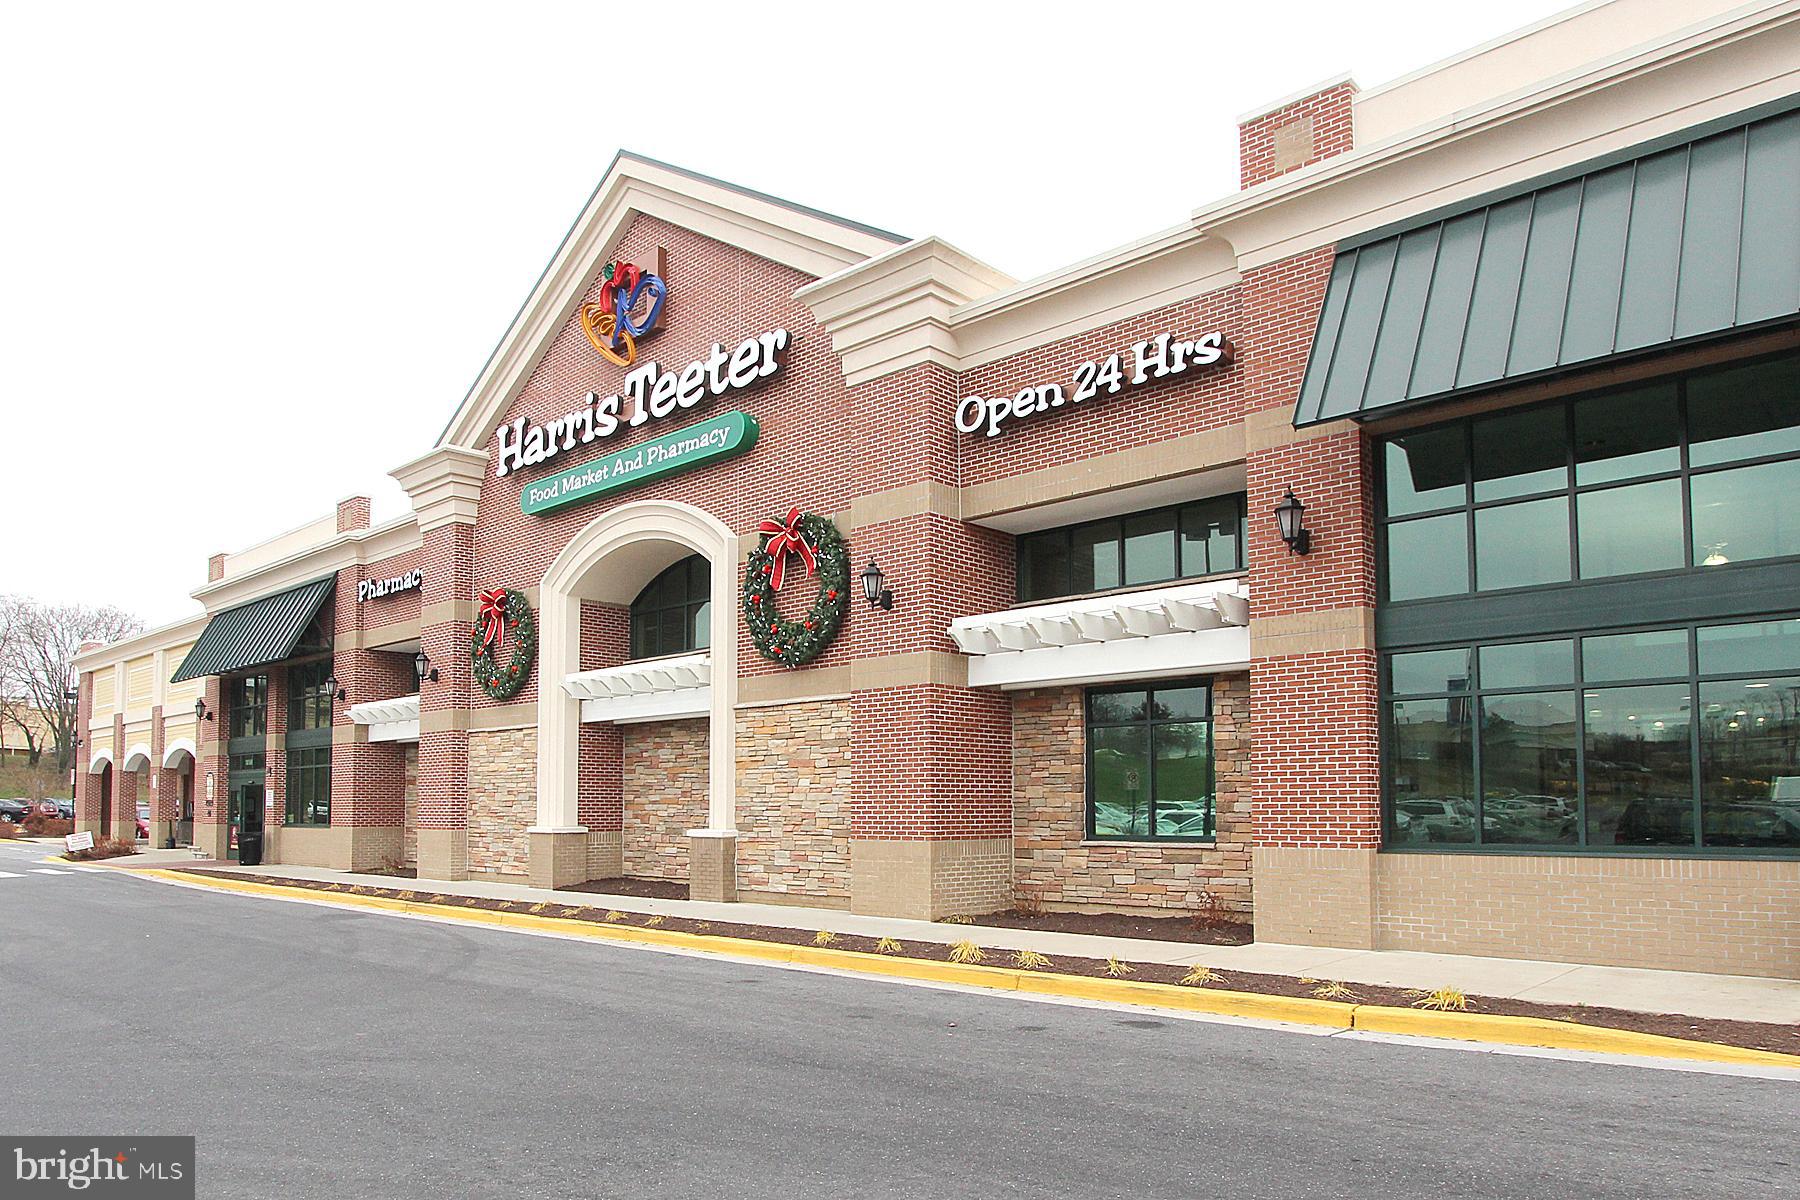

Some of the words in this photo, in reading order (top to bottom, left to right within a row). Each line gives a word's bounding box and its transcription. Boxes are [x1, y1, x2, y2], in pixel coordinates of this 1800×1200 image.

[495, 391, 621, 478] Harris
[624, 328, 789, 428] Teeter
[954, 382, 1066, 438] Open
[1071, 353, 1124, 403] 24
[1130, 331, 1223, 386] Hrs
[529, 482, 559, 506] Food
[561, 464, 610, 493] Market
[611, 451, 644, 477] And
[646, 425, 731, 466] Pharmacy
